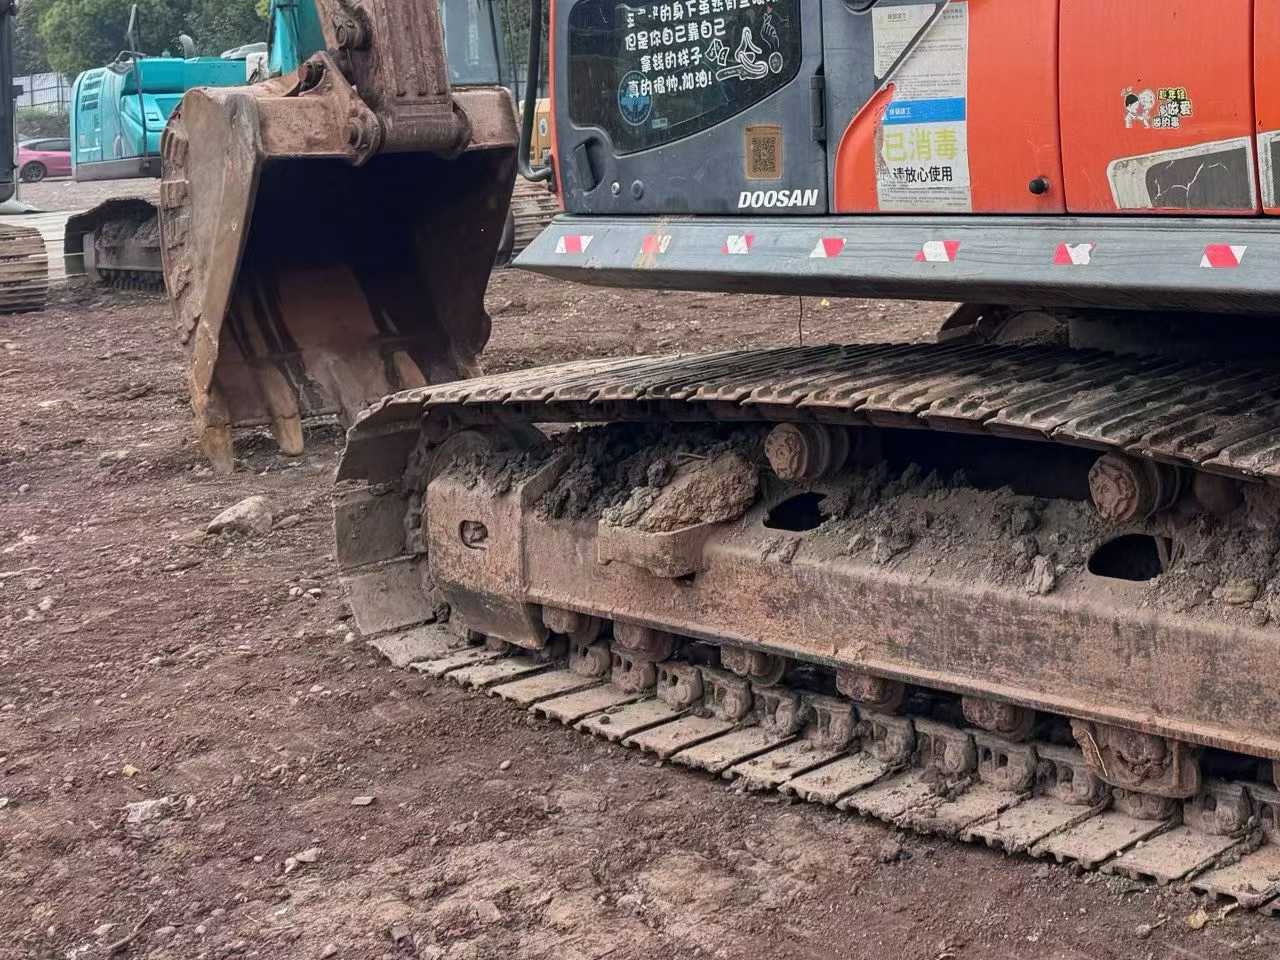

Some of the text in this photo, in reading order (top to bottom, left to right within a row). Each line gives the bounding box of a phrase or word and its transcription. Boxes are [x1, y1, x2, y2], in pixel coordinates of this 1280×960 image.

[624, 17, 727, 52] 但是你自己靠自己
[640, 45, 703, 74] 拿钱的样子
[885, 127, 957, 161] 已消毒
[738, 189, 818, 209] DOOSAN
